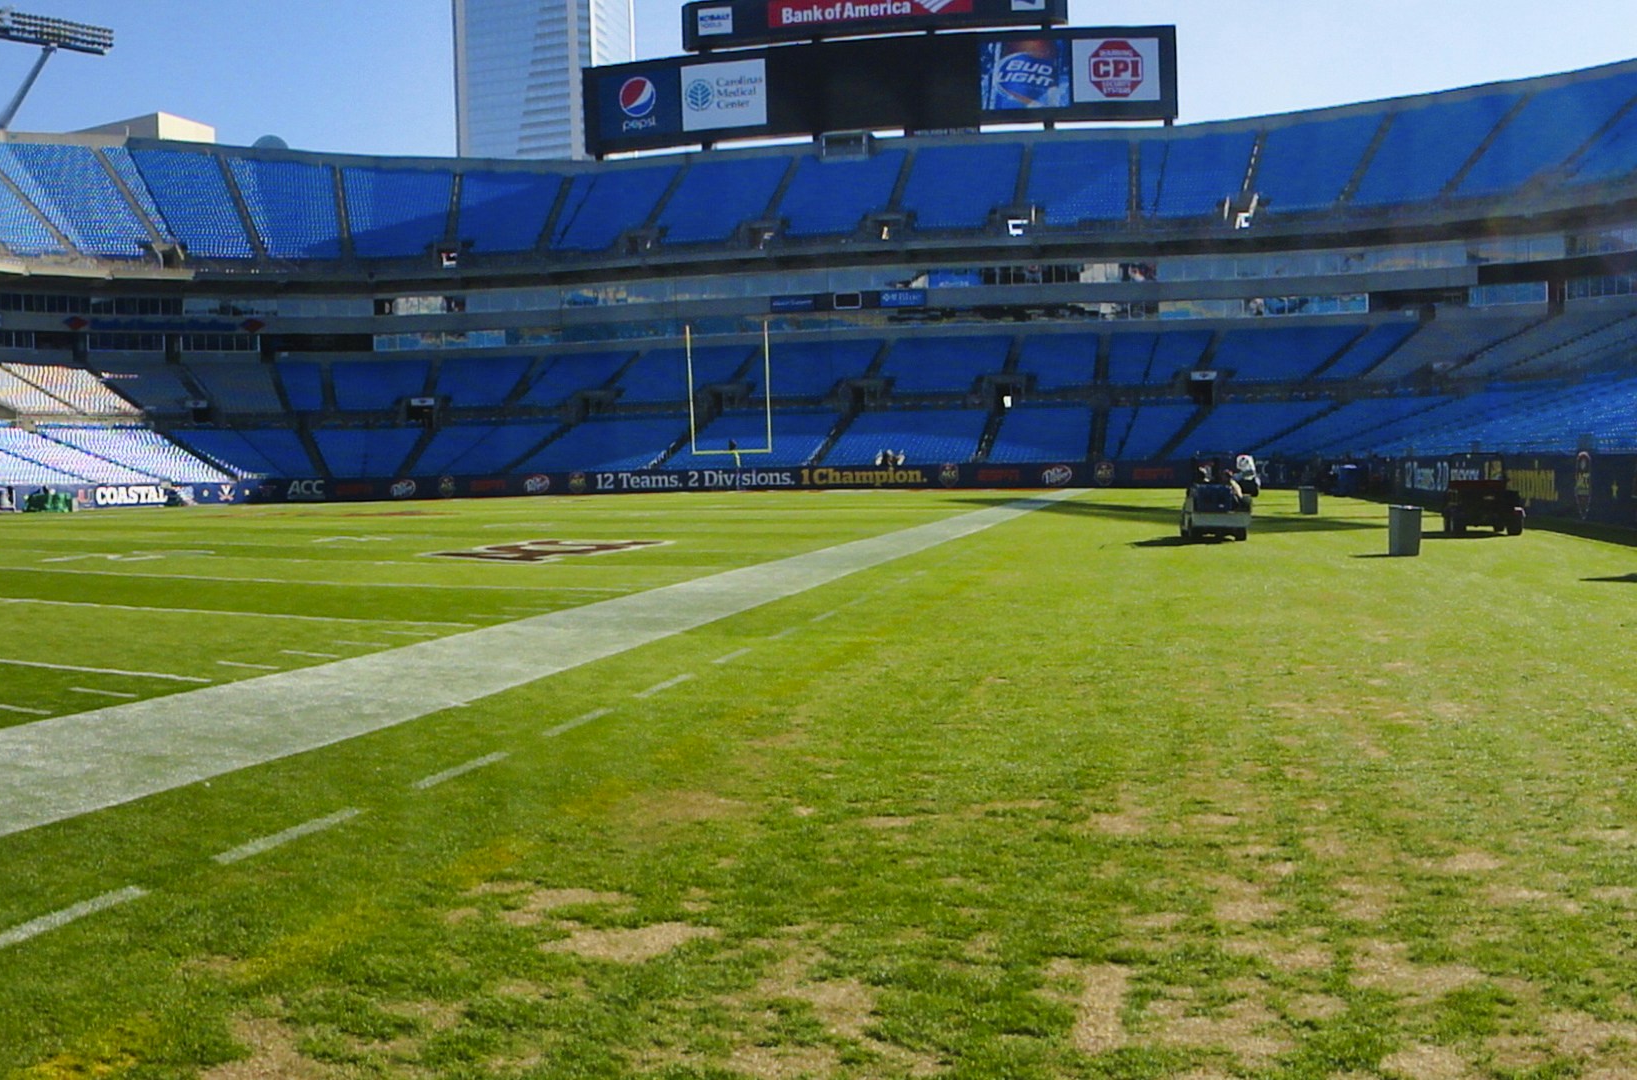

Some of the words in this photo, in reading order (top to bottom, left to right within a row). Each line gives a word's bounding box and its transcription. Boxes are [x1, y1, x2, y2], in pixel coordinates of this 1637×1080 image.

[781, 6, 822, 24] Bank
[824, 4, 843, 19] of
[842, 1, 911, 19] America
[1005, 59, 1053, 75] BUD
[1092, 59, 1140, 78] CPI
[716, 75, 763, 88] Carolinas
[996, 71, 1053, 87] LIGHT
[716, 87, 756, 99] Medical
[717, 99, 750, 111] Center
[622, 116, 657, 133] pepsi
[596, 473, 614, 490] 12
[619, 472, 683, 489] Teams.
[688, 471, 698, 487] 2
[801, 469, 810, 485] 1
[812, 467, 928, 487] Champion.
[95, 484, 168, 505] COASTAL
[286, 480, 325, 495] ACC
